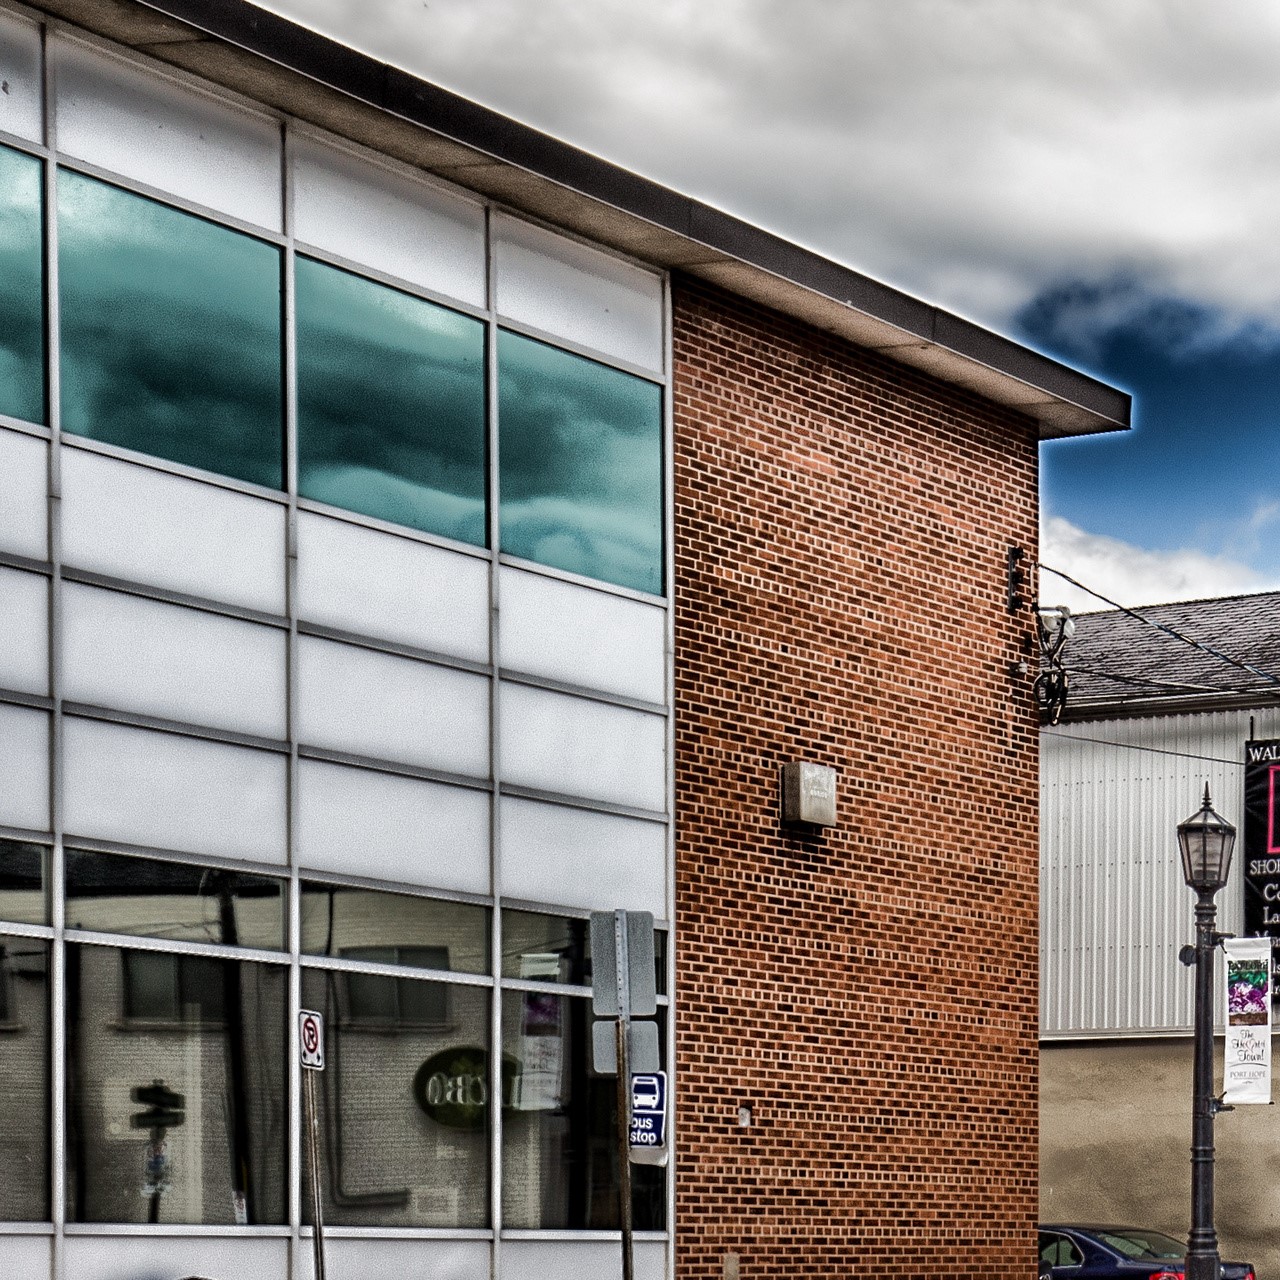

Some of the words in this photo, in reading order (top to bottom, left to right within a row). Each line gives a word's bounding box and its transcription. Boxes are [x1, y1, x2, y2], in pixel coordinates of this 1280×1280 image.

[1240, 1029, 1253, 1039] The
[1237, 1049, 1264, 1061] Town!
[631, 1117, 653, 1129] bus
[630, 1130, 657, 1145] stop
